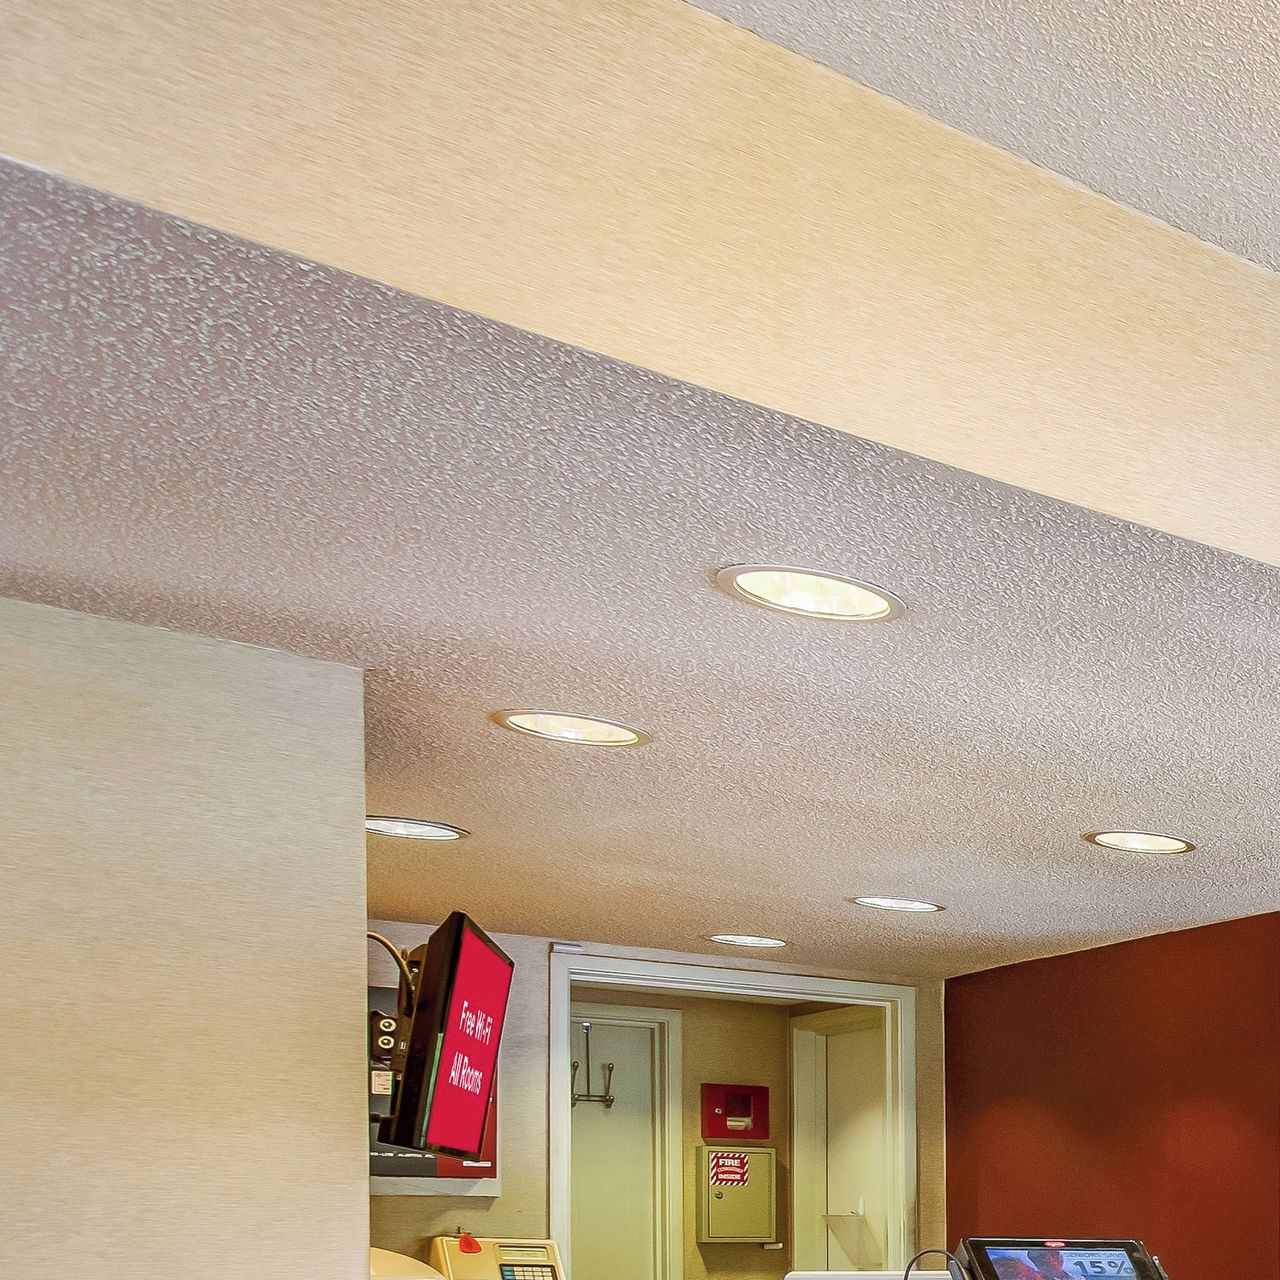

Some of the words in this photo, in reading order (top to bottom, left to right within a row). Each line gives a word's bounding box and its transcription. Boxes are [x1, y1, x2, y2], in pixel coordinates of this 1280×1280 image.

[459, 1000, 476, 1037] Free
[474, 1009, 493, 1046] Wi-Fi
[448, 1051, 464, 1087] All
[459, 1055, 483, 1096] Rooms
[718, 1159, 741, 1167] FIRE
[1073, 1260, 1135, 1275] 15%
